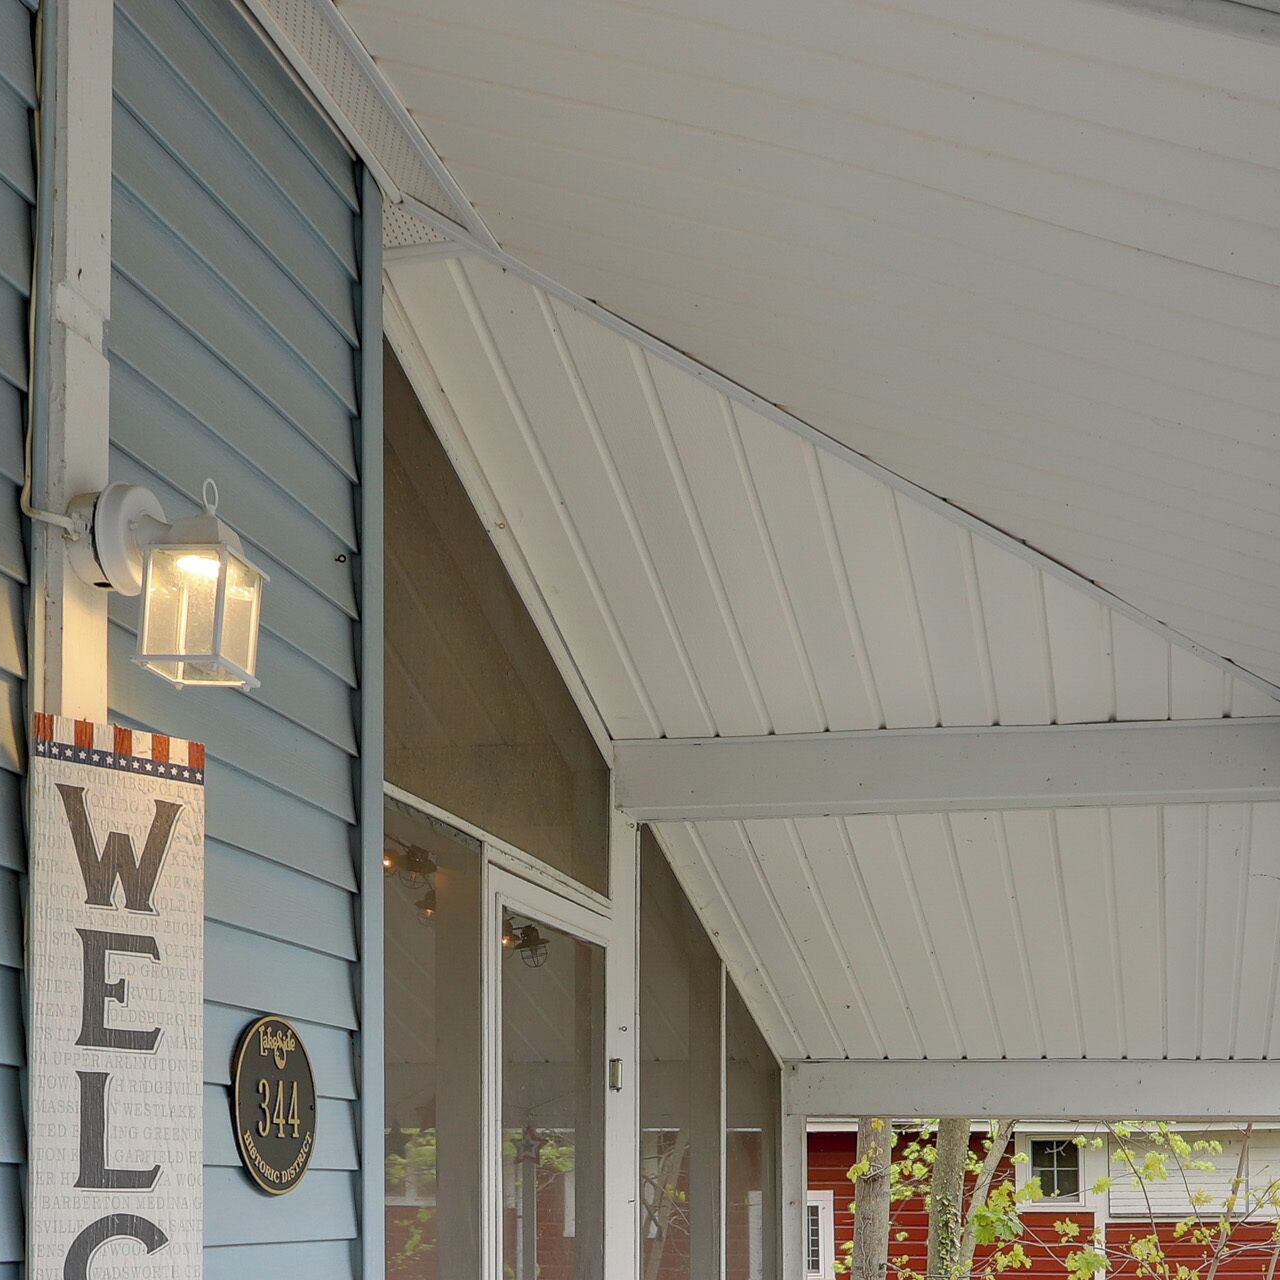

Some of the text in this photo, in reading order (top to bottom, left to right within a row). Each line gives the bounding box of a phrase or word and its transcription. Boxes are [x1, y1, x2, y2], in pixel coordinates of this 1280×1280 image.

[77, 768, 156, 794] COLUMBUS
[53, 1051, 101, 1069] UPPER
[105, 1055, 187, 1073] ARLINGTON
[123, 1102, 196, 1119] WESTLAKE
[258, 1078, 300, 1138] 344
[143, 1126, 190, 1142] GREEN
[114, 1148, 184, 1165] GARFIELD
[243, 1129, 312, 1184] HISTORIC DISTRICT
[42, 1195, 189, 1211] BARBERTON MEDINA
[93, 1264, 180, 1280] WADSWORTH
